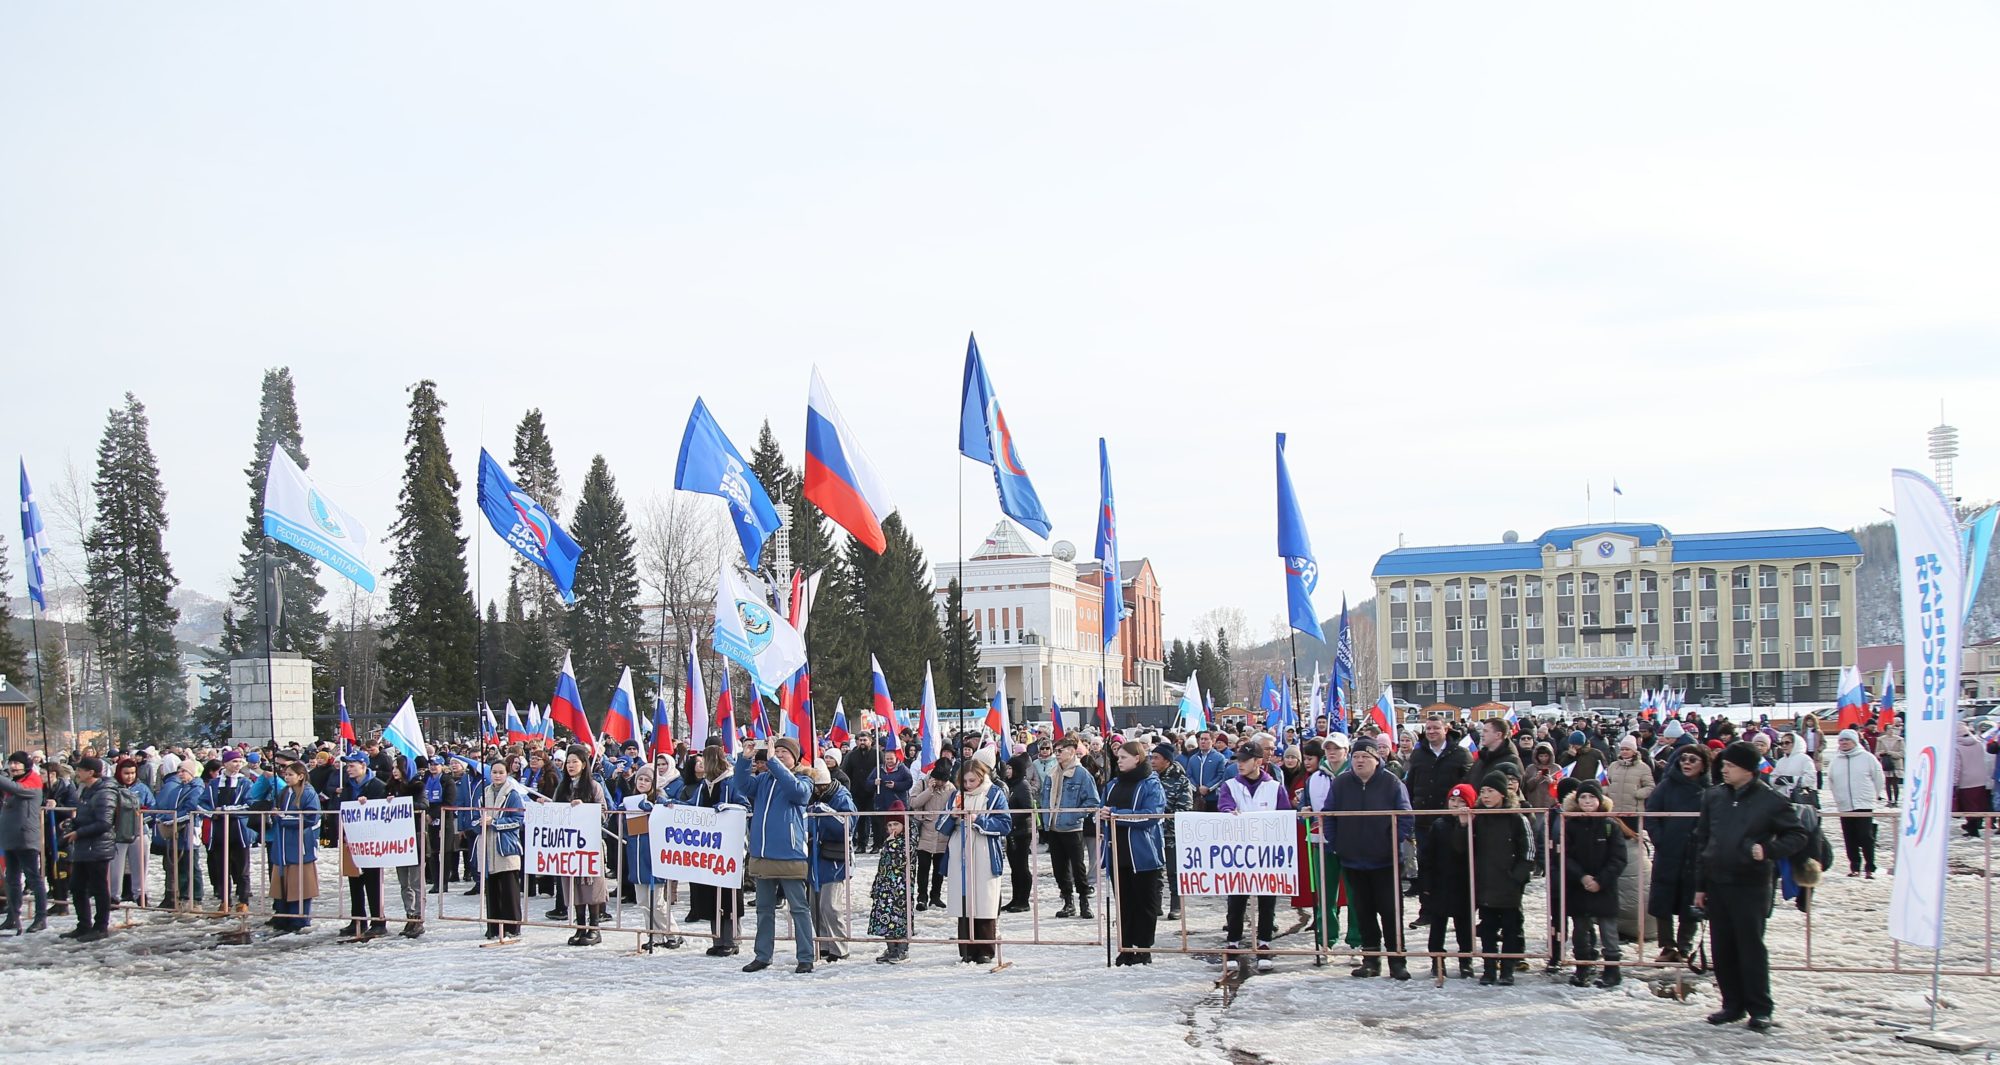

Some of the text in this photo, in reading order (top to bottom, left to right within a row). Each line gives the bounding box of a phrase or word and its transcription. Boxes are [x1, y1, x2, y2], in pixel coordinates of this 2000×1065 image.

[276, 525, 358, 576] РЕСПУБЛИКА АЛТАЙ
[341, 803, 412, 824] ПОКА МЫ ЕДИНЫ
[527, 805, 572, 825] ВРЕМЯ
[674, 809, 718, 826] КРЫМ
[532, 826, 587, 849] РЕШАТЬ
[665, 826, 722, 850] РОССИЯ
[1181, 815, 1289, 844] ВСТАНЕМ!
[537, 850, 600, 876] ВМЕСТЕ
[660, 848, 737, 876] НАВСЕГДА
[1182, 844, 1294, 869] ЗА РОССИЮ!
[1179, 871, 1297, 895] НАС МИЛЛИОНЫ
